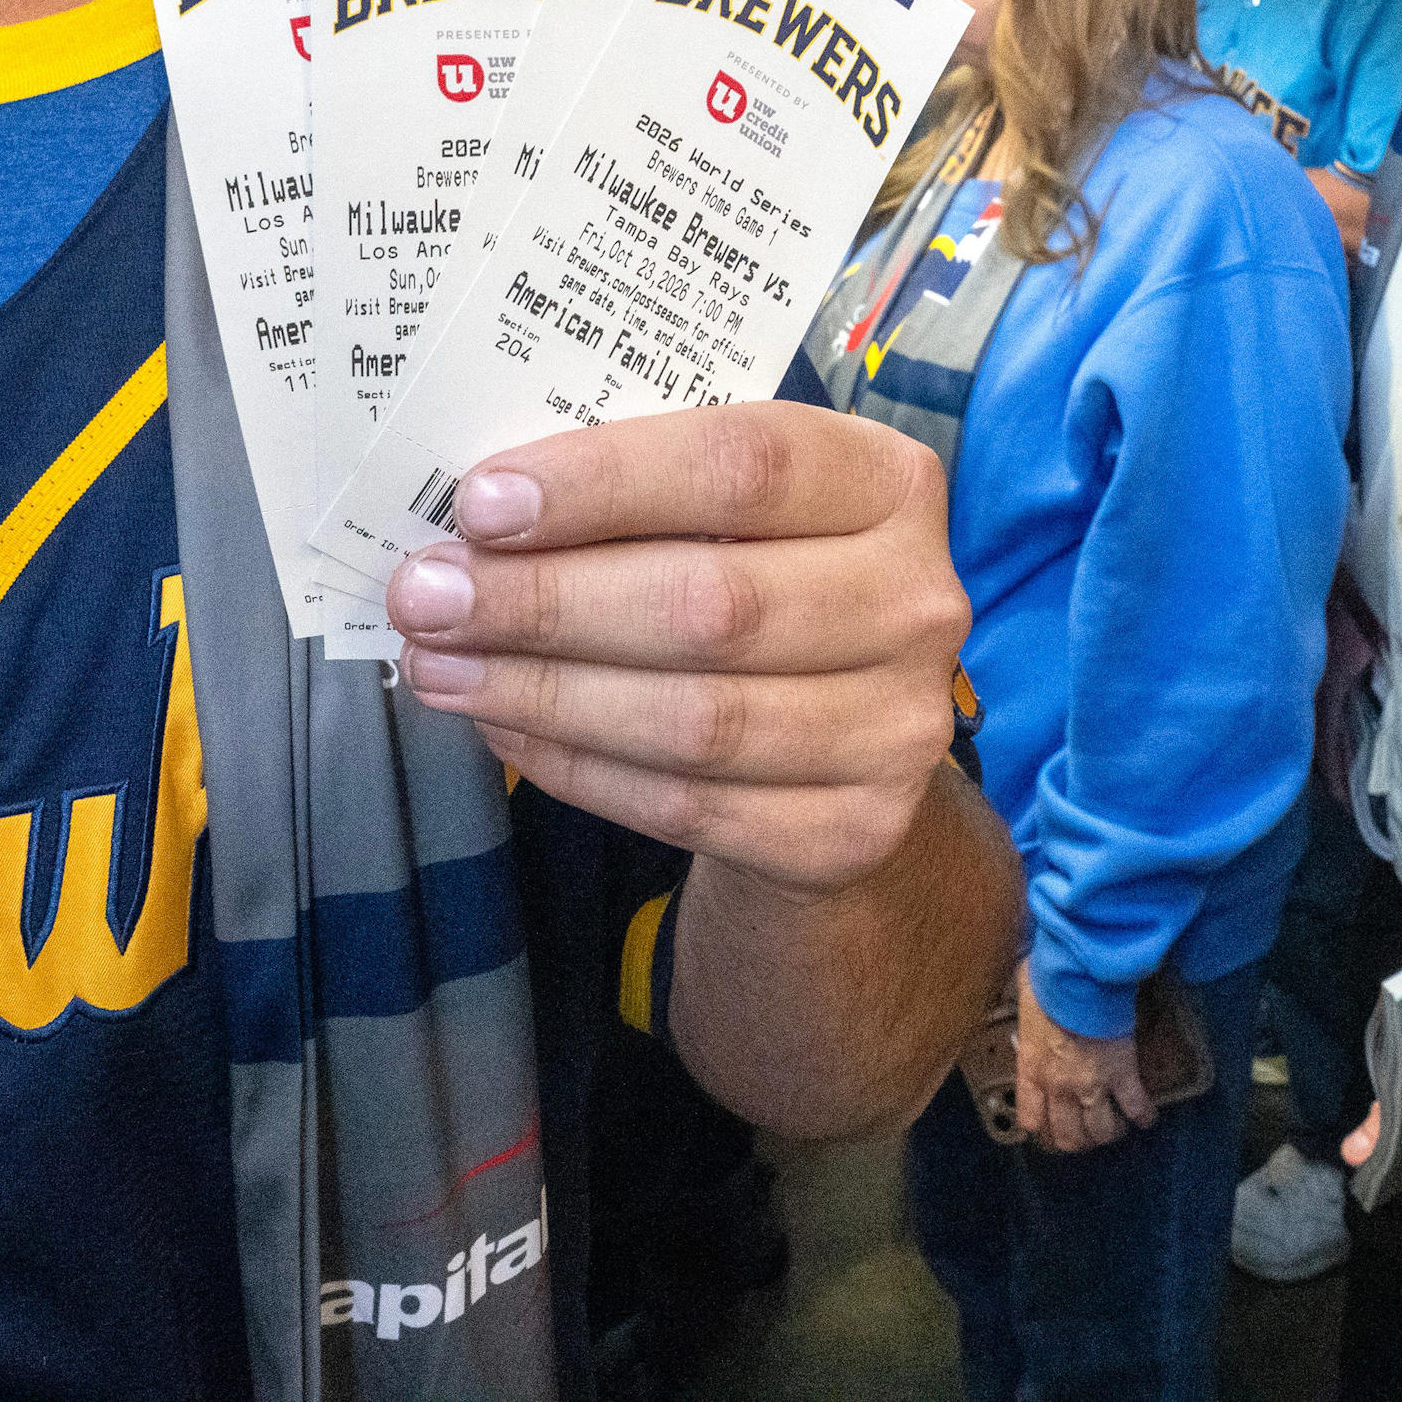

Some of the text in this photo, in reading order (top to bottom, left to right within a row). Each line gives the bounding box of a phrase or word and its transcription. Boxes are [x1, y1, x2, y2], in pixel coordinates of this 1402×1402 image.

[436, 29, 520, 40] PRESENTED
[726, 50, 810, 110] PRESENTED BY
[752, 96, 777, 119] uw
[738, 122, 783, 158] union
[745, 112, 790, 146] credit
[635, 113, 812, 238] 2026 World Series
[646, 149, 780, 246] Brewers Home Game 1
[244, 214, 284, 234] Los
[573, 143, 792, 307] Milwaukee Brewers vs.
[359, 243, 398, 260] Los
[605, 204, 750, 307] Tampa Bay Rays
[240, 268, 277, 291] Visit
[345, 298, 380, 316] Visit
[532, 225, 756, 371] Visit Brewers.com/postseason for official
[691, 290, 723, 322] 7:00
[724, 311, 745, 335] PM
[256, 317, 313, 350] Amer
[497, 312, 541, 343] Section
[505, 270, 746, 408] American Family Fiel
[559, 273, 716, 375] game date, time, and details.
[352, 344, 407, 377] Amer
[495, 332, 532, 364] 204
[604, 373, 623, 390] Row
[546, 387, 606, 427] Loge Blea
[595, 390, 610, 407] 2
[344, 519, 376, 540] Order
[344, 622, 378, 631] Order
